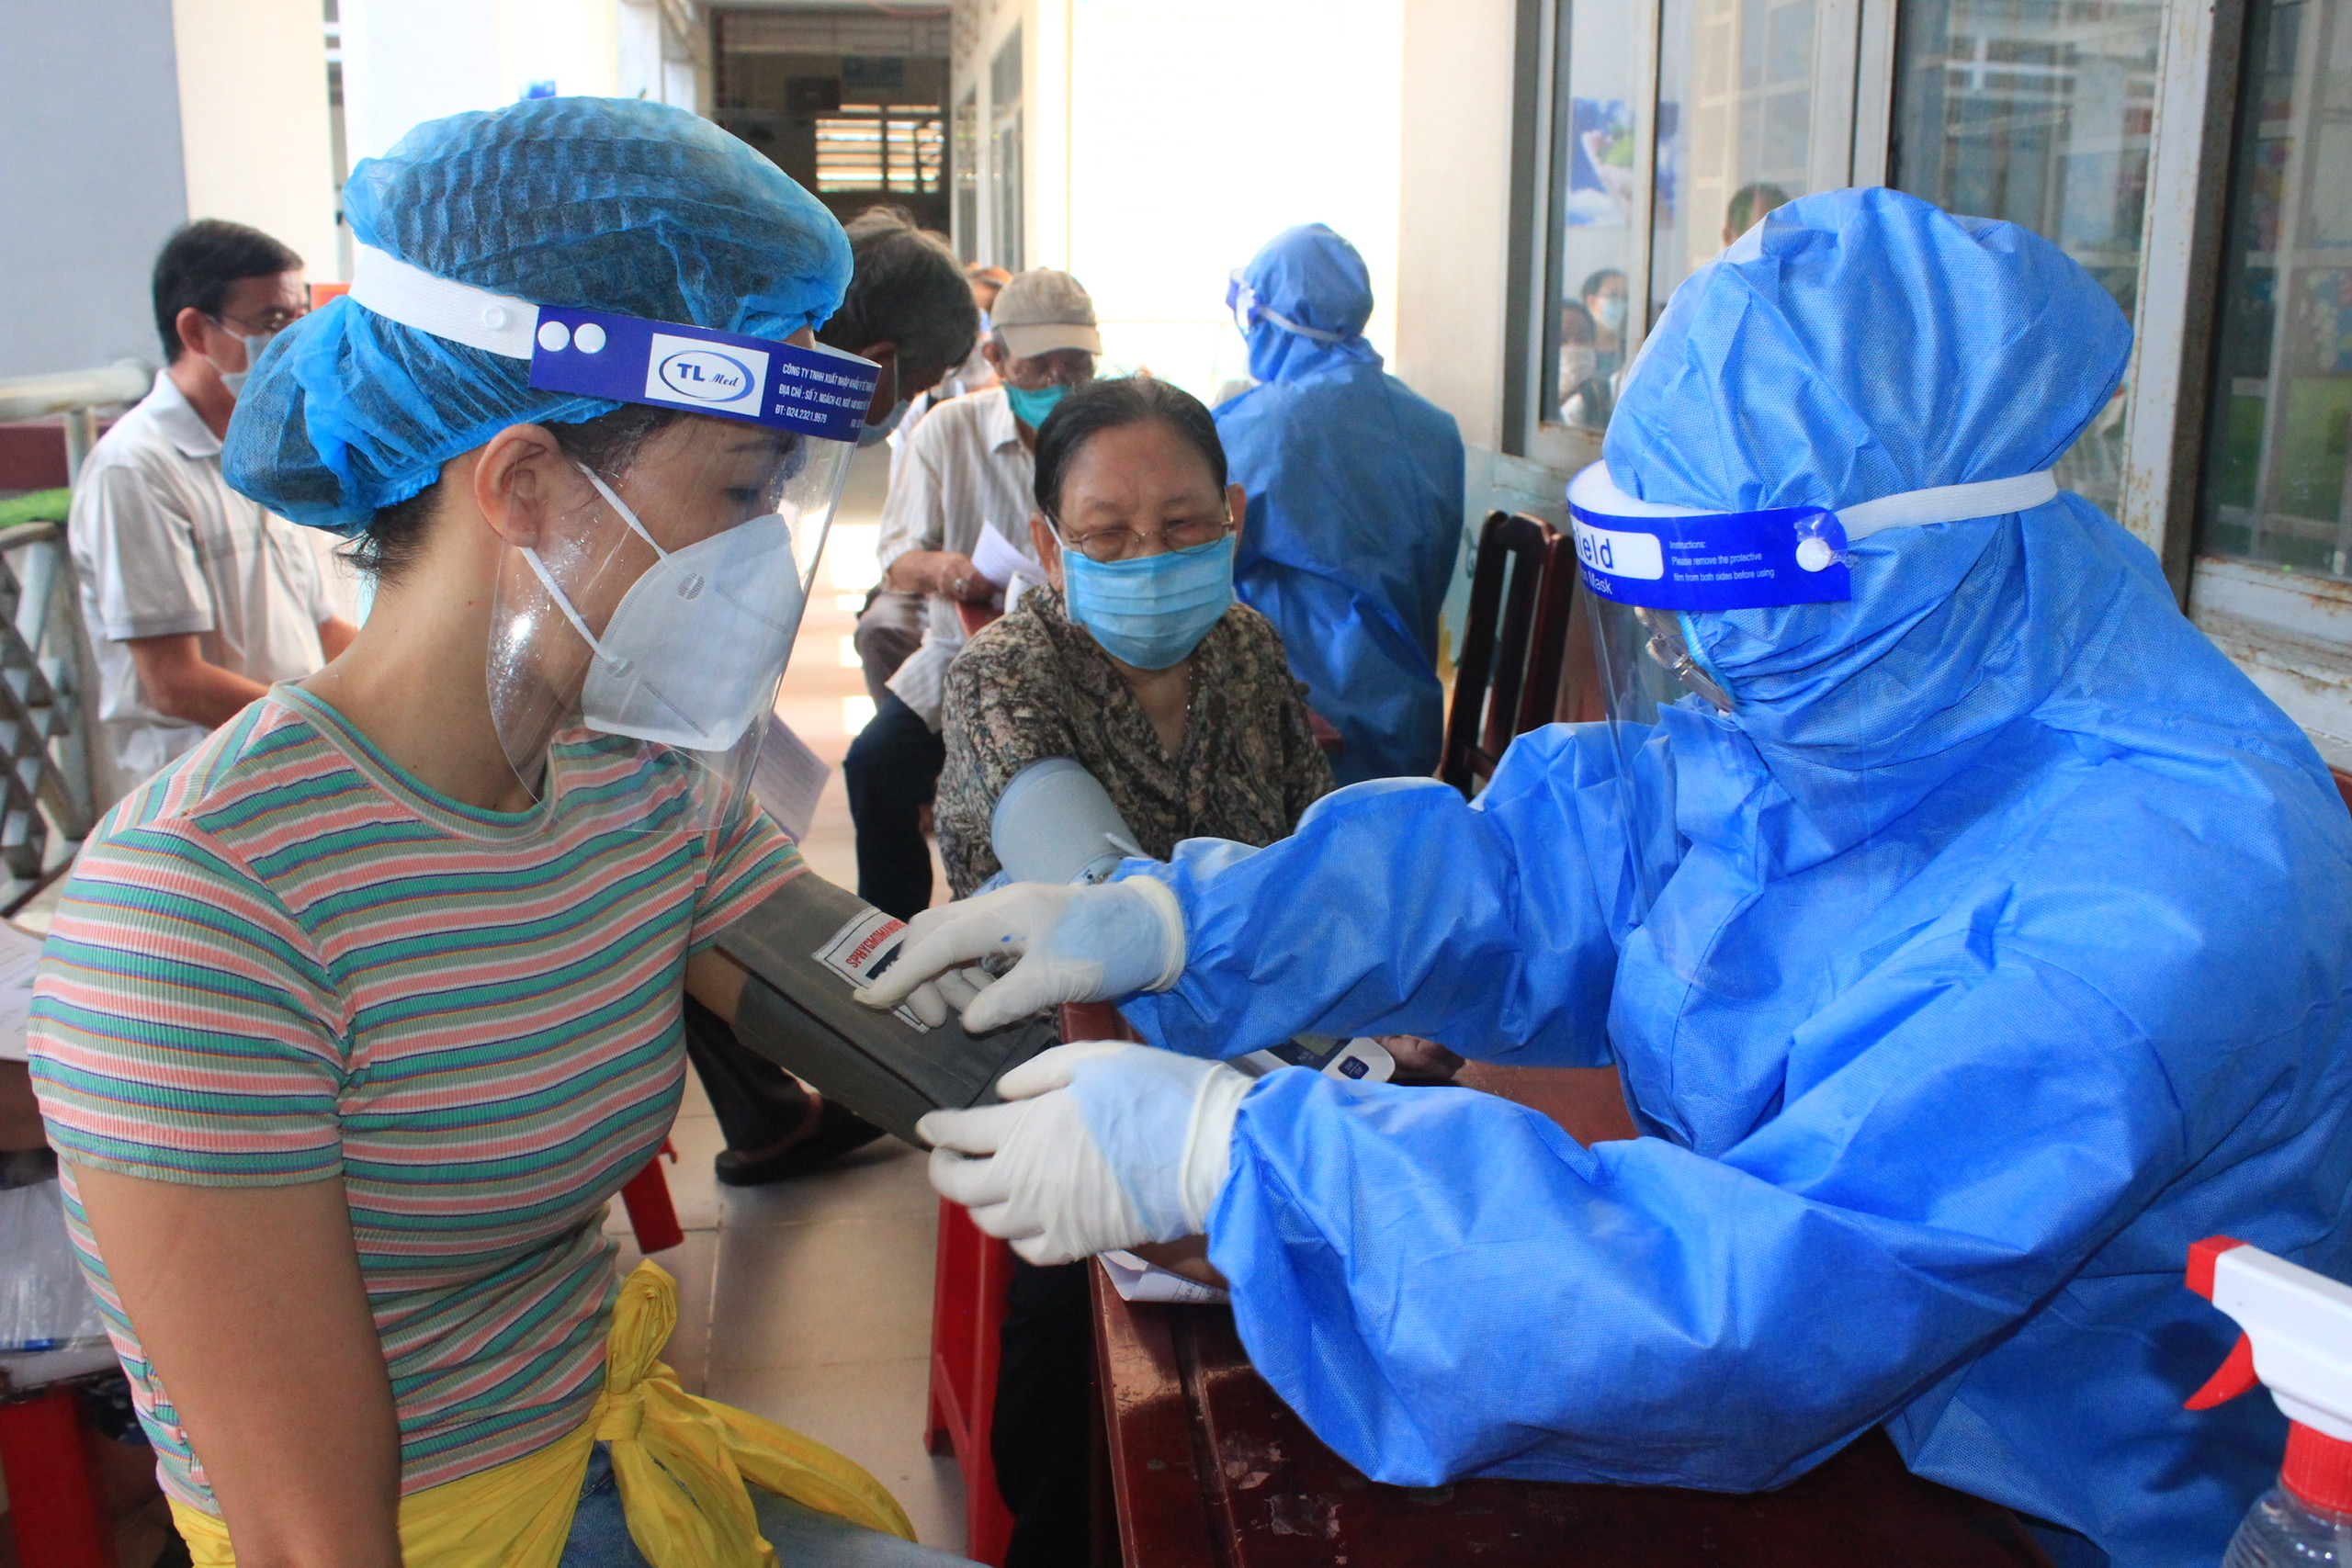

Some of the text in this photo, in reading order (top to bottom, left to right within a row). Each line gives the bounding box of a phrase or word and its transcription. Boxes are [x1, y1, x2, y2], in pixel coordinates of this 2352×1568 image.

[676, 363, 739, 387] TL Med
[783, 363, 800, 378] CÔNG
[801, 367, 808, 378] TY
[809, 369, 825, 382] TNHH
[779, 383, 790, 398] ĐỊA
[790, 385, 803, 399] CHỈ
[804, 388, 815, 401] SỐ
[1669, 540, 1706, 549] Instructions:
[1671, 552, 1762, 566] Please remove the protective
[1673, 569, 1775, 581] film from both sides before using
